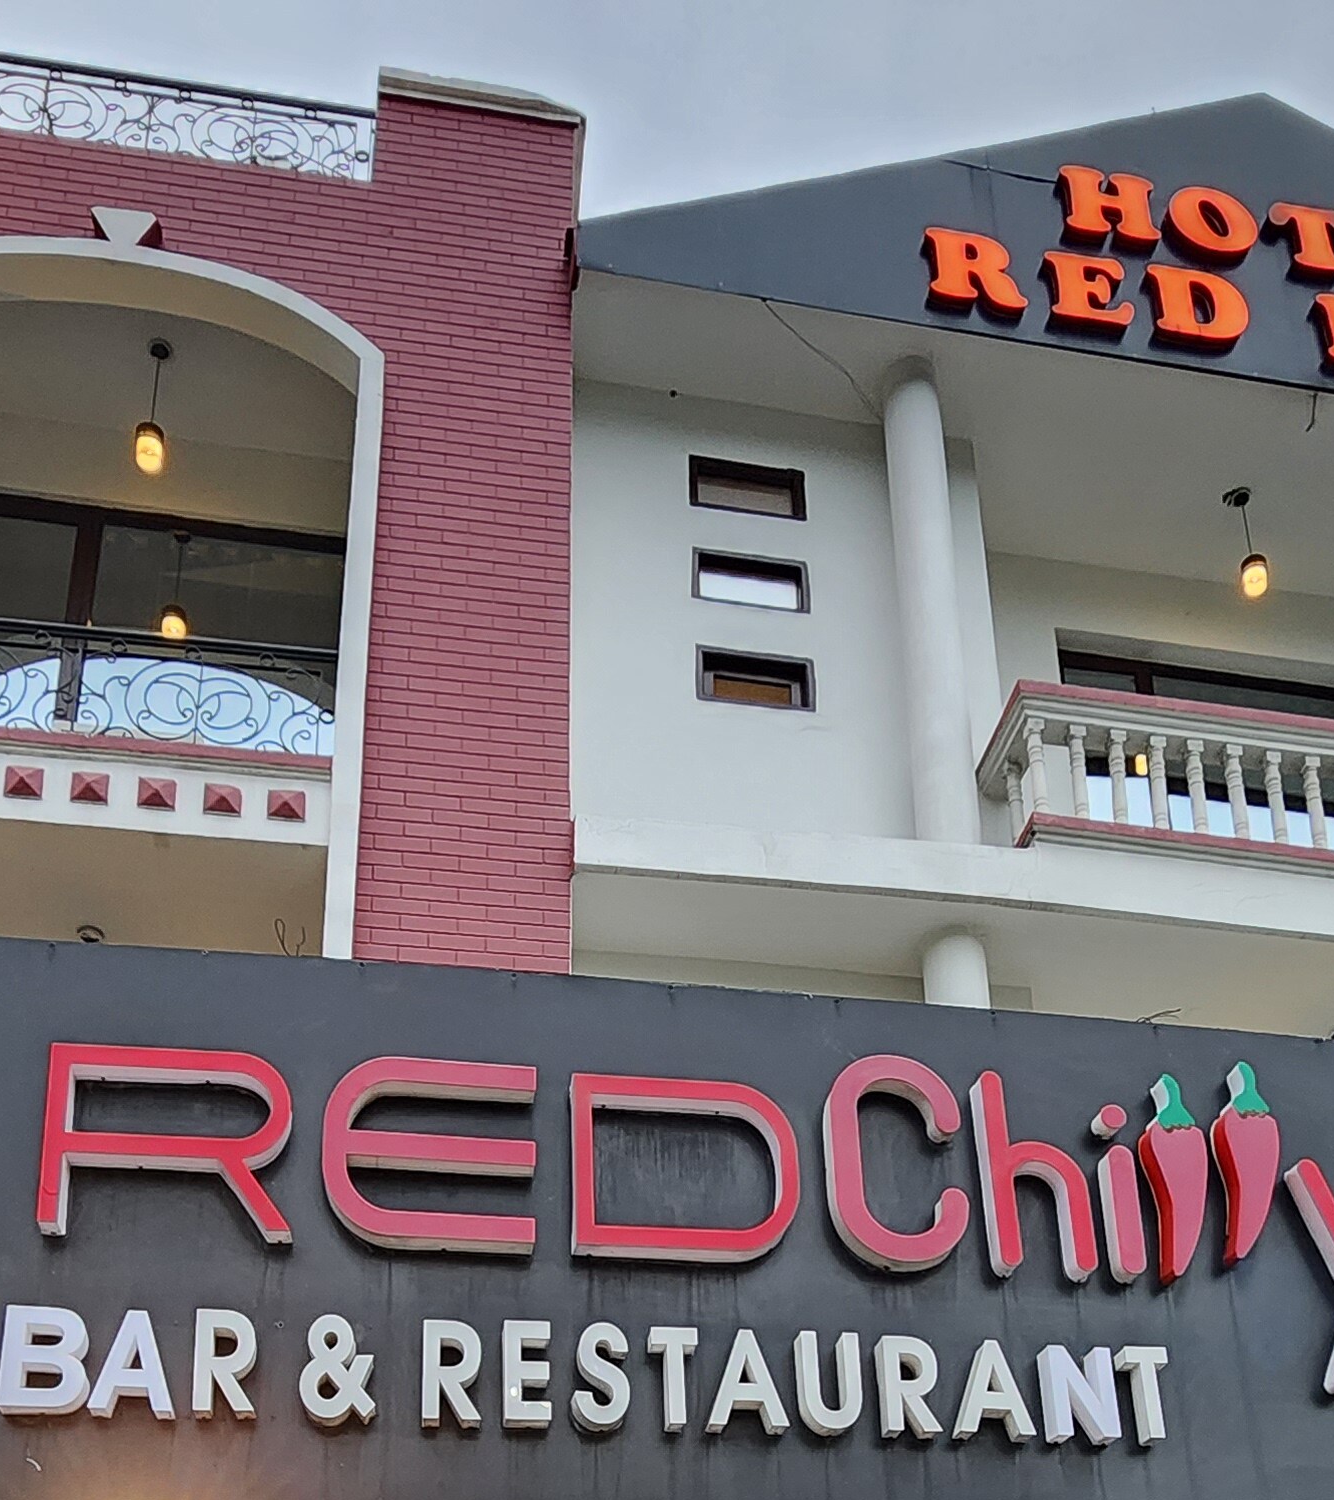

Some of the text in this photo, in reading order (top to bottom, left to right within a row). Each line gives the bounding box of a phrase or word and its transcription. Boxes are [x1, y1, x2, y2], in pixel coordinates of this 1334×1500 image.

[924, 226, 1251, 348] RED
[36, 1042, 801, 1265] RED
[298, 1313, 377, 1427] &
[419, 1318, 1170, 1447] RESTAURANT
